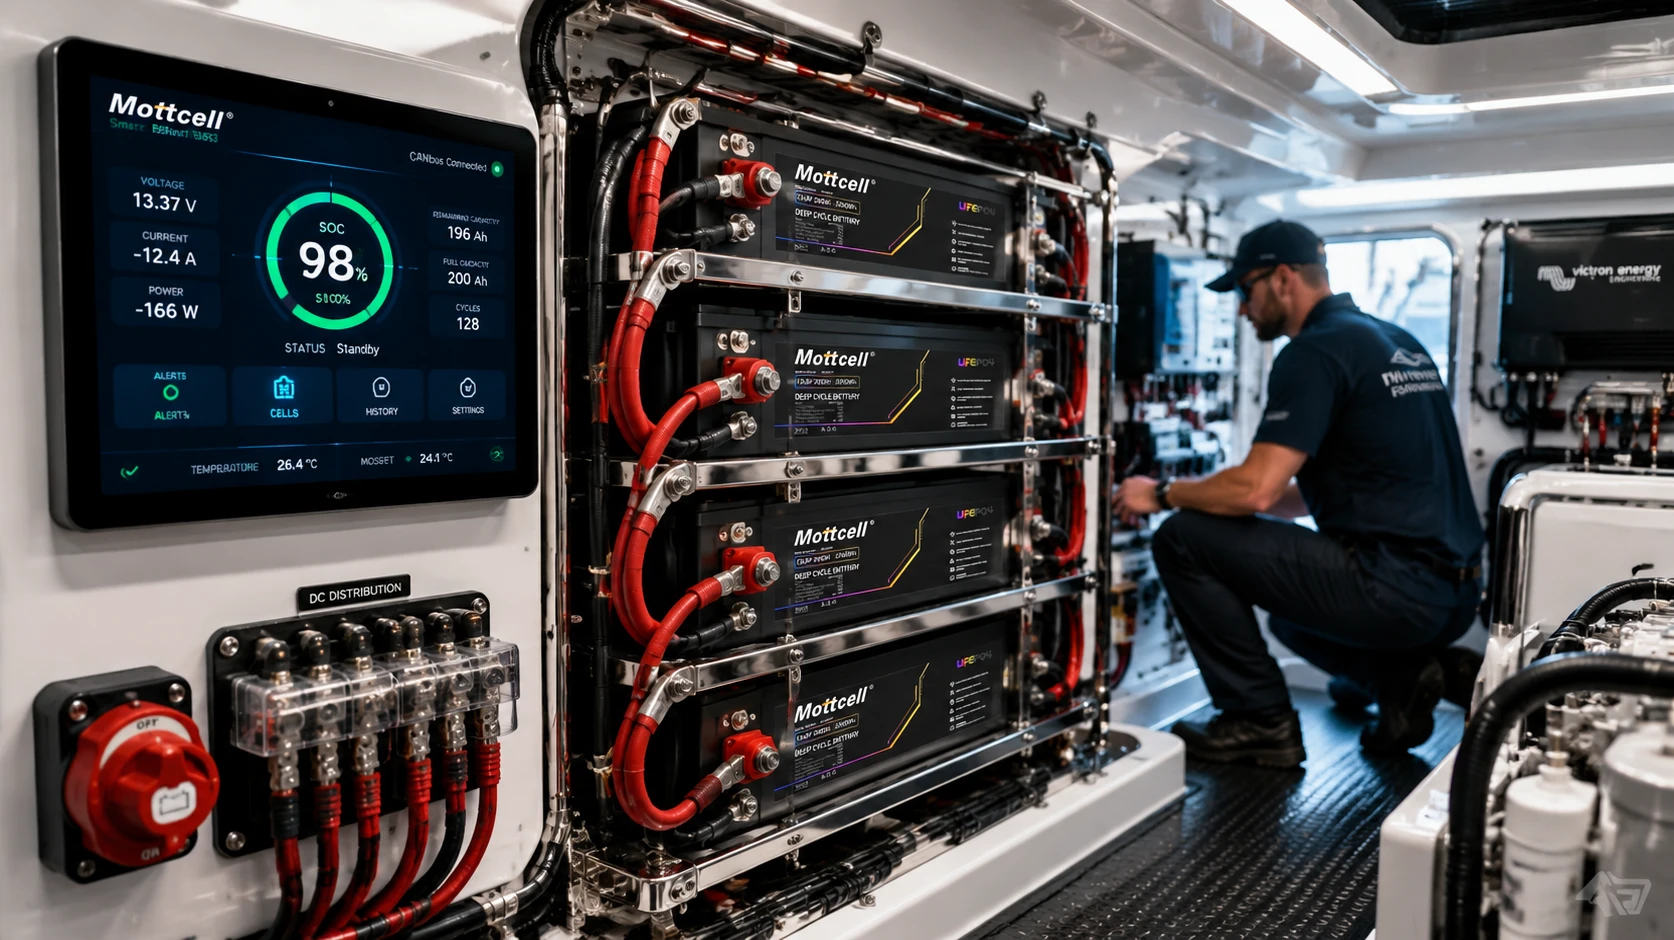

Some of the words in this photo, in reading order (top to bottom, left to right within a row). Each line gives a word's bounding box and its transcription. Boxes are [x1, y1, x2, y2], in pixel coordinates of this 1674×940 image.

[140, 176, 185, 190] VOLTAGE
[133, 192, 181, 212] 13.37
[185, 198, 197, 213] V
[319, 221, 346, 235] SOC
[447, 225, 471, 241] 196
[473, 230, 488, 243] Ah
[142, 230, 189, 244] CURRENT
[133, 246, 181, 265] -12.4
[185, 251, 197, 267] A
[1571, 264, 1614, 277] victron
[1617, 264, 1662, 278] energy
[447, 271, 471, 286] 200
[474, 275, 488, 287] Ah
[148, 285, 184, 297] POWER
[135, 302, 178, 319] -166
[182, 304, 199, 320] W
[455, 303, 481, 313] CYCLES
[456, 316, 480, 331] 128
[284, 342, 326, 354] STATUS
[270, 408, 300, 419] CELLS
[365, 407, 399, 417] HISTORY
[309, 592, 326, 605] DC
[329, 582, 402, 602] DISTRIBUTION
